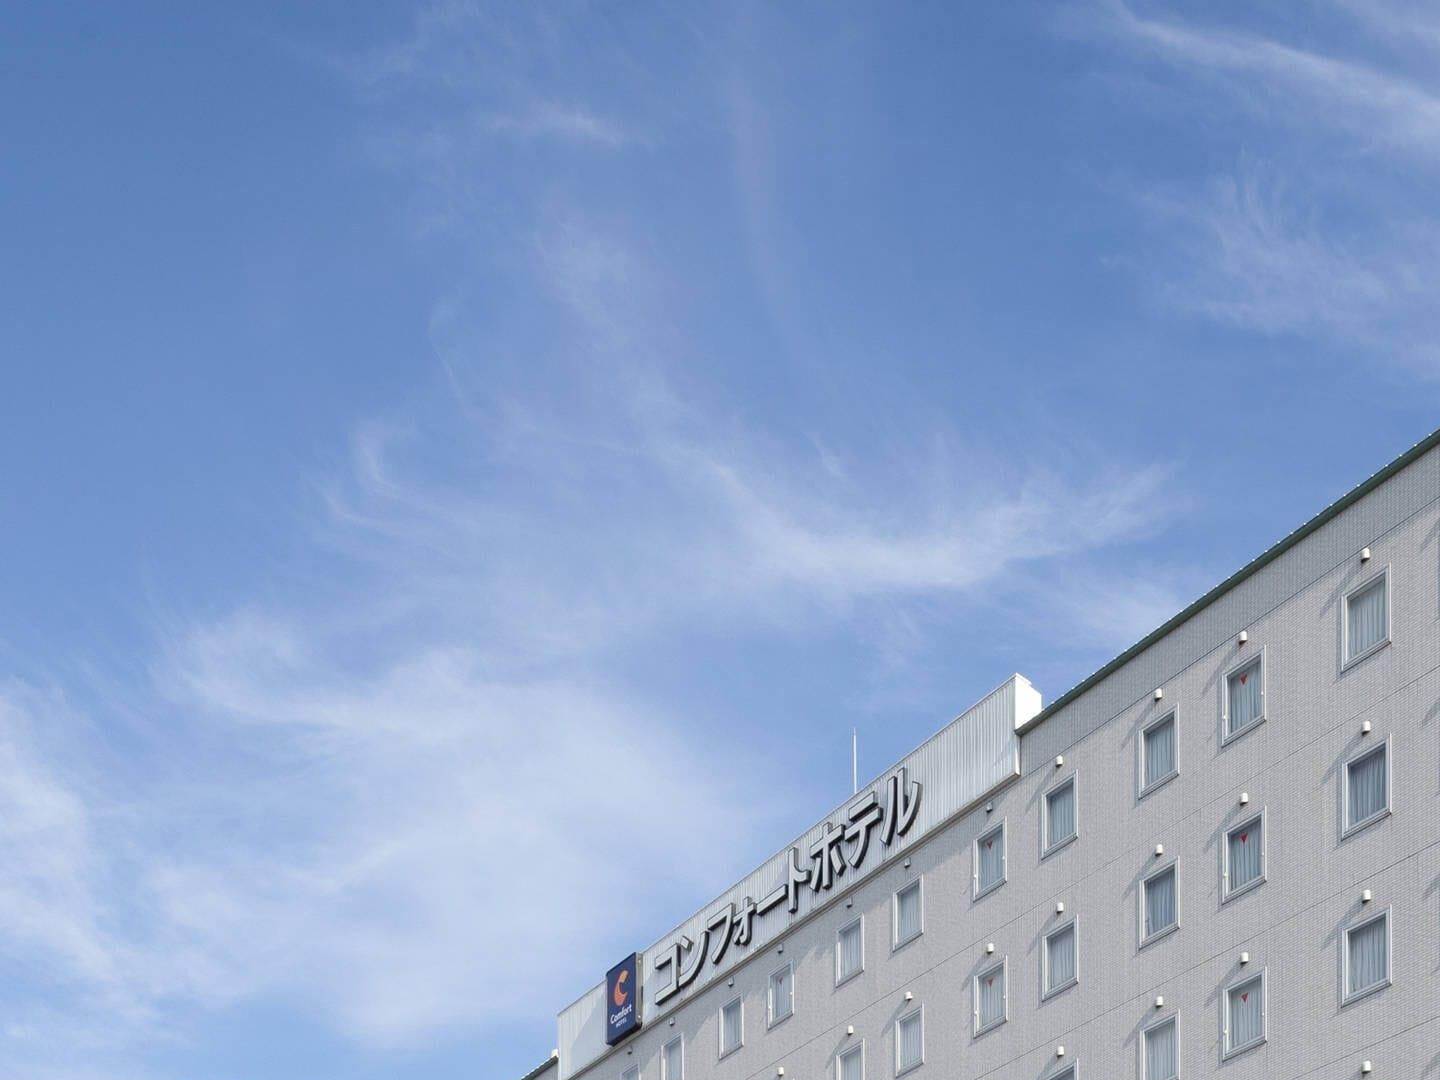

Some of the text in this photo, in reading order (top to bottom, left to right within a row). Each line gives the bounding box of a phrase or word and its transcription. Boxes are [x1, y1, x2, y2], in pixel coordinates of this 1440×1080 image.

[655, 768, 920, 1006] コンフォートホテル
[610, 1004, 633, 1024] Comfort
